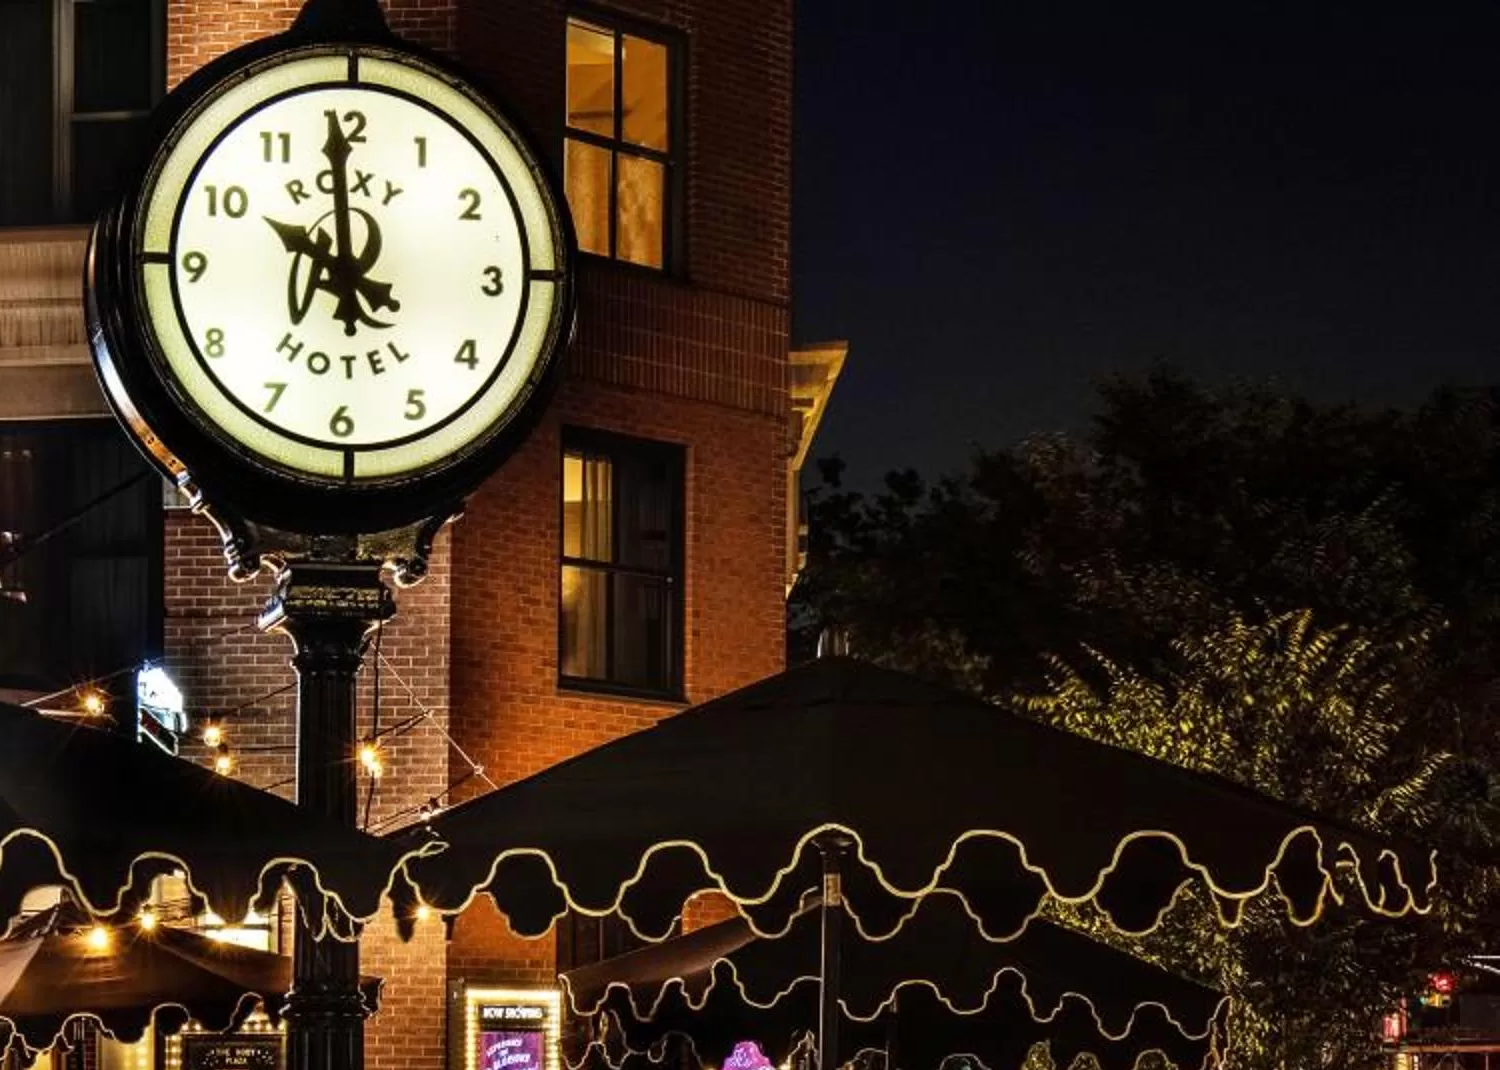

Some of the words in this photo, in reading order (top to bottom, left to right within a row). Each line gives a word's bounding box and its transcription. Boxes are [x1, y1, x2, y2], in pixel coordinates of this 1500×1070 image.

[323, 110, 367, 142] 12
[260, 131, 291, 164] 11
[414, 137, 427, 168] 1
[204, 185, 248, 218] 10
[285, 168, 404, 205] ROXY
[457, 188, 482, 221] 2
[182, 251, 208, 283] 9
[481, 266, 504, 297] 3
[205, 328, 225, 359] 8
[276, 332, 411, 380] HOTEL
[454, 339, 480, 370] 4
[263, 382, 288, 413] 7
[404, 390, 427, 421] 5
[329, 406, 355, 438] 6
